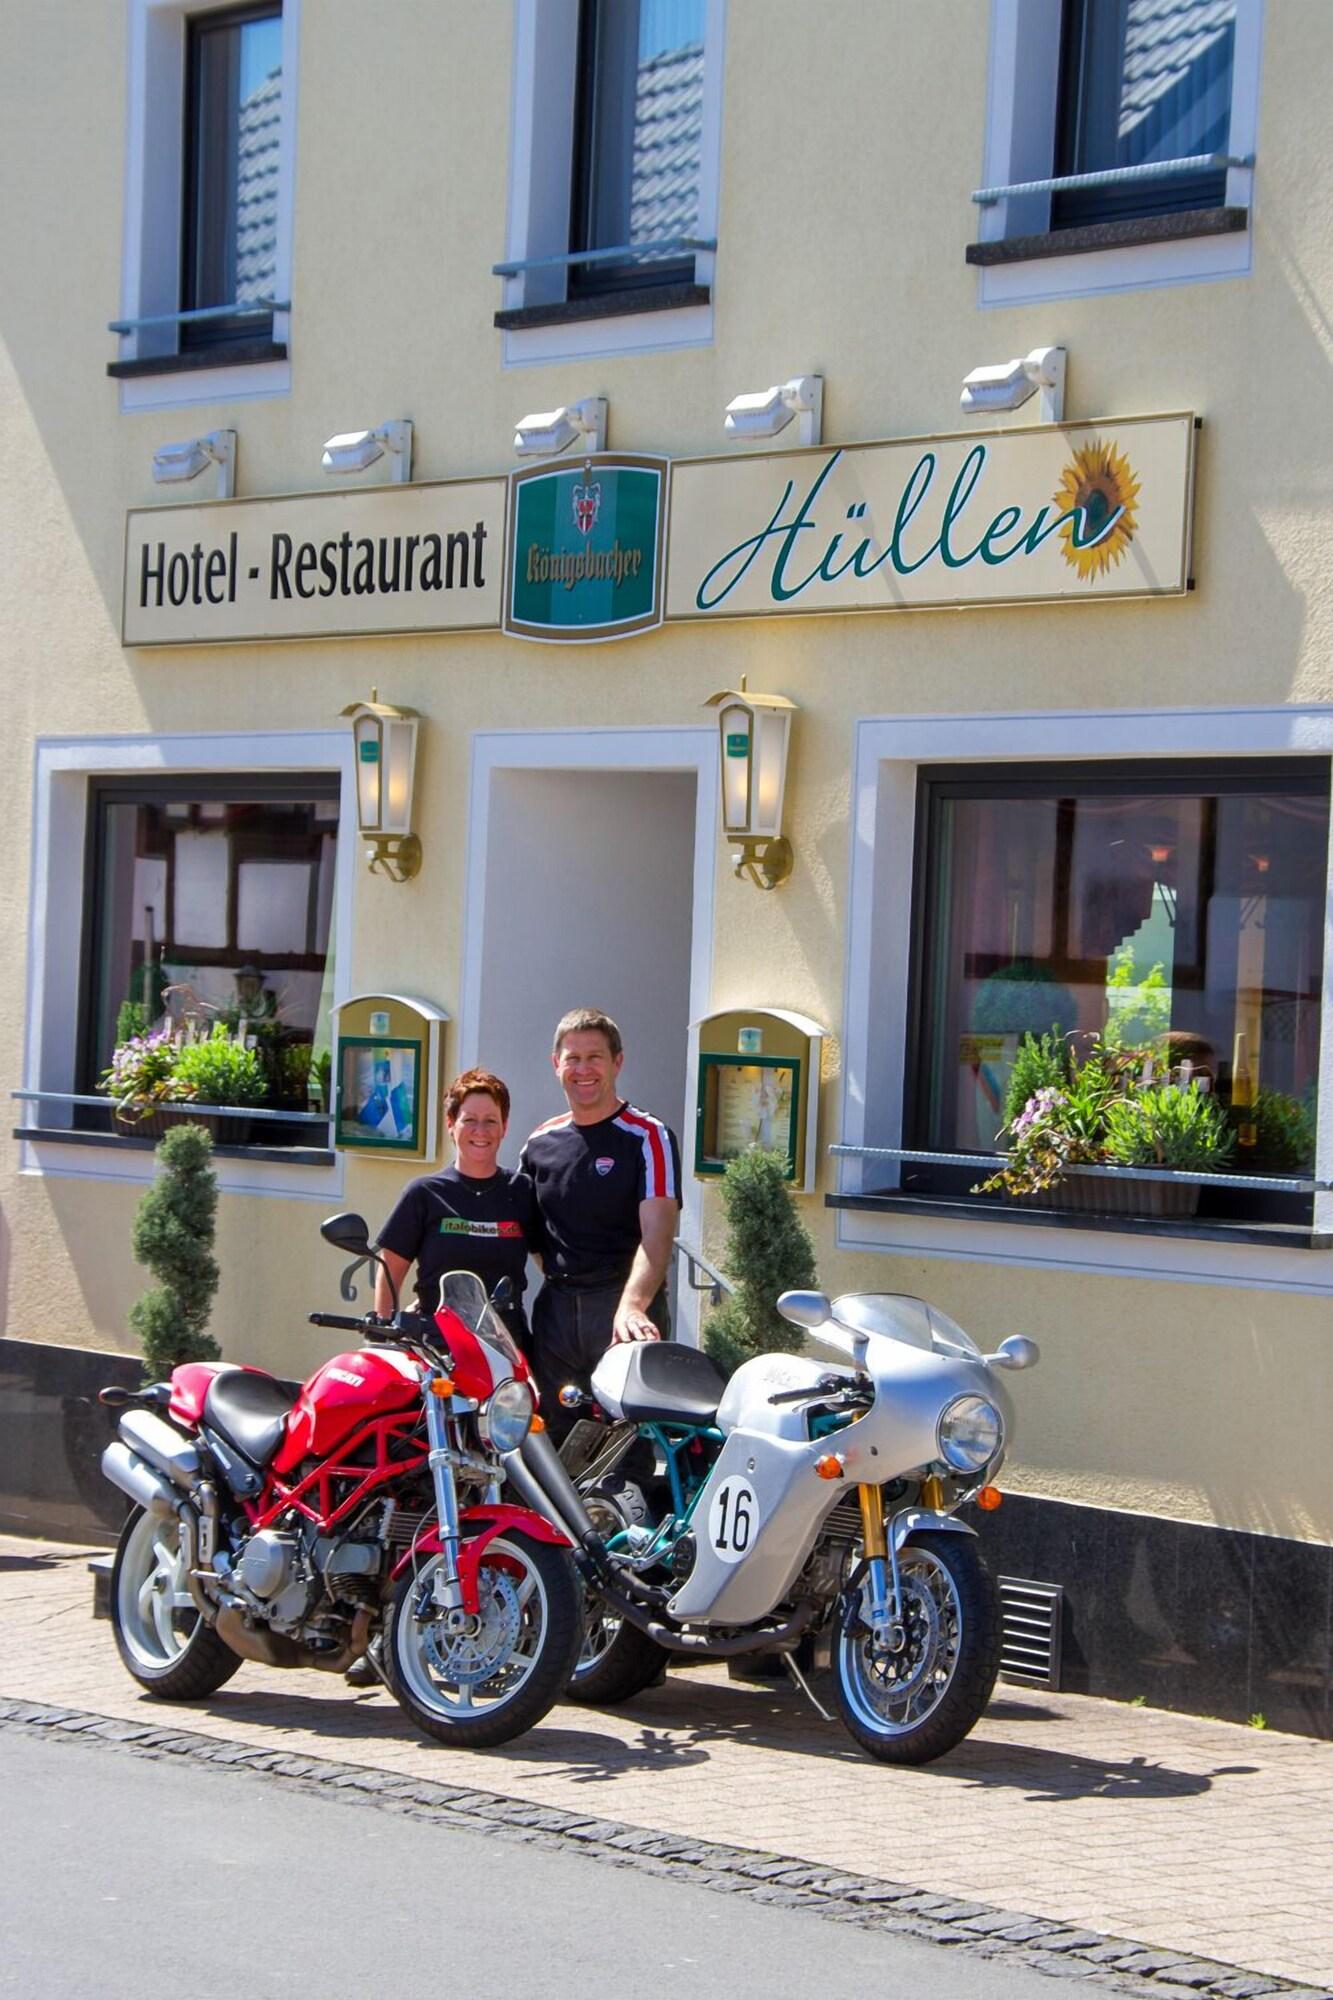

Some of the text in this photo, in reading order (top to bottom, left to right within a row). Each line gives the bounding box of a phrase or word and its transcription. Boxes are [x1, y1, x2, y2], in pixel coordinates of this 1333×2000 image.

[140, 532, 238, 608] Hotel
[270, 521, 487, 600] Restaurant
[696, 445, 1126, 610] Hüllen
[325, 1367, 366, 1388] CATI
[715, 1486, 752, 1552] 16
